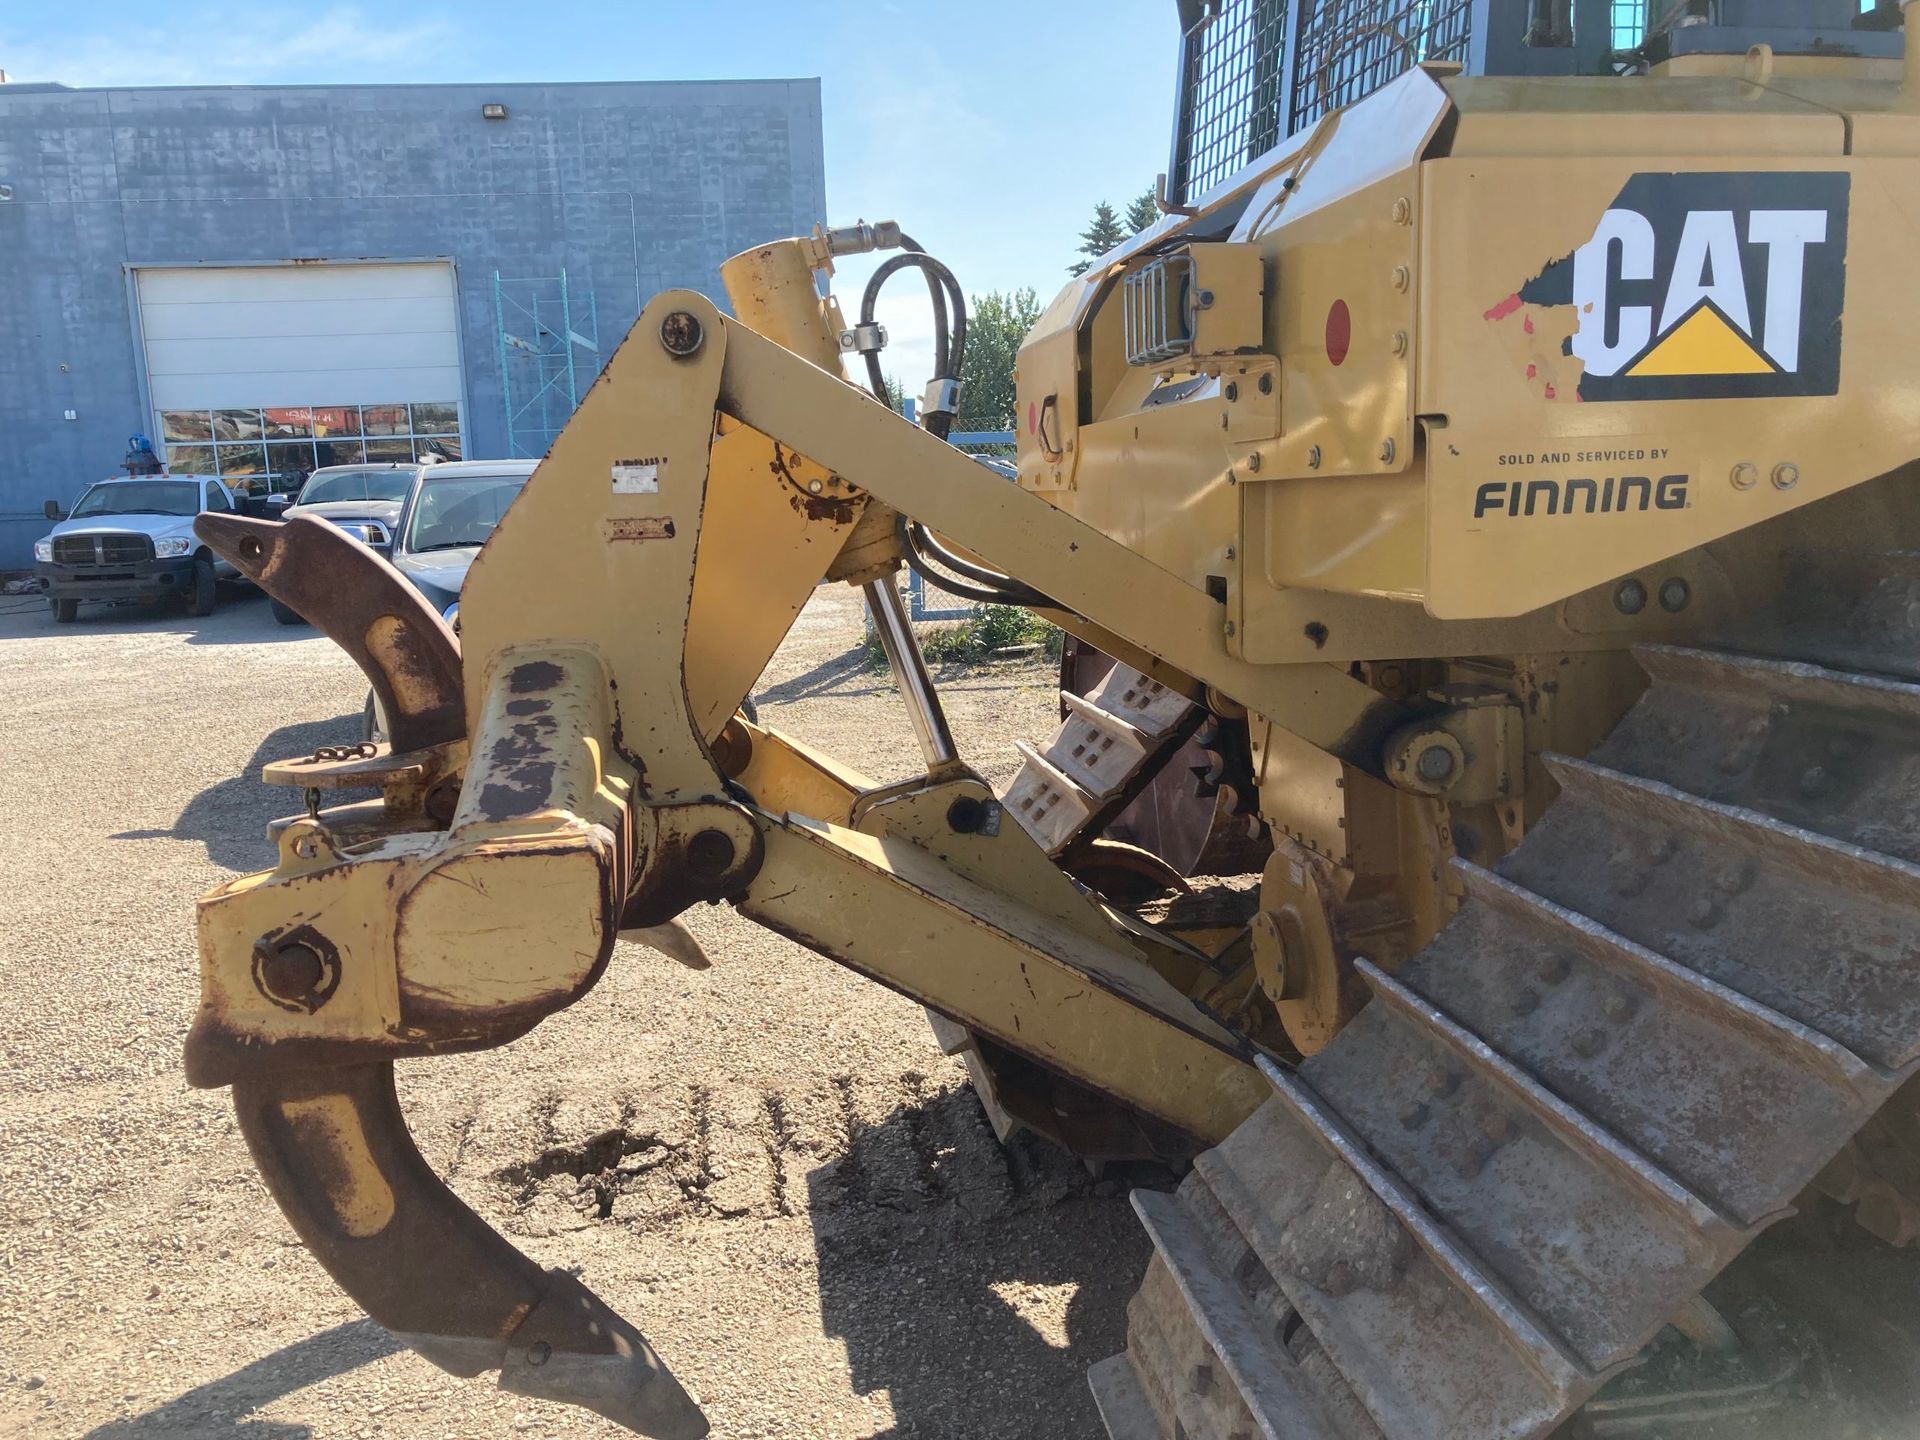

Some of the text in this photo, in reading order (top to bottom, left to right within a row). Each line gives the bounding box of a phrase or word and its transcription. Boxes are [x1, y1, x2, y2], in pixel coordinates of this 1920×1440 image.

[1571, 208, 1828, 377] CAT
[1498, 448, 1669, 466] SOLD AND SERVICED BY
[1474, 474, 1689, 518] FINNING
